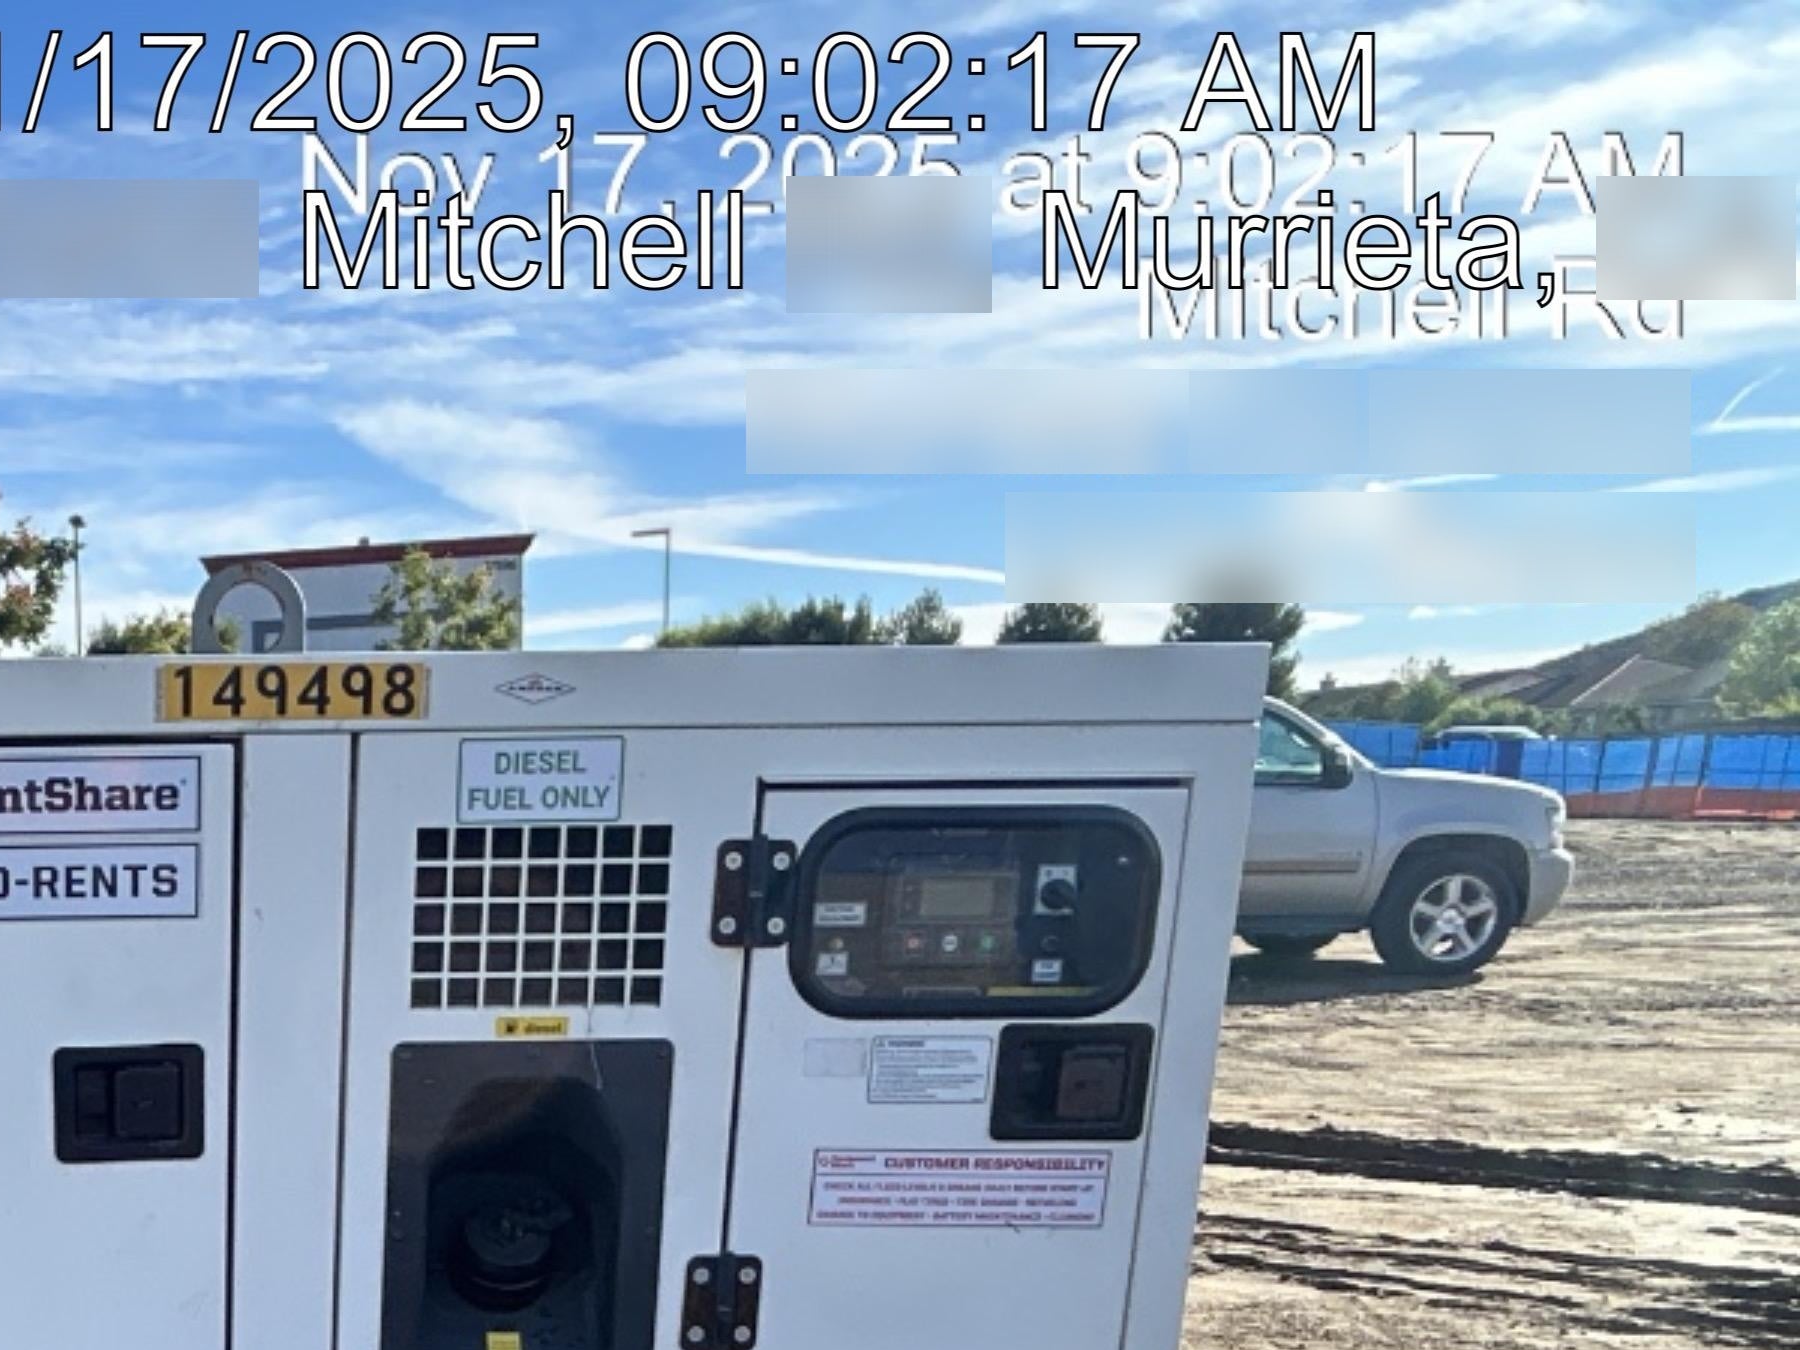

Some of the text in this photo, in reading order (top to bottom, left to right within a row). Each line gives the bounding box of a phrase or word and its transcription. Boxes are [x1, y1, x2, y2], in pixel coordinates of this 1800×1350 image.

[174, 663, 415, 717] 149498
[494, 751, 587, 775] DIESEL
[467, 785, 611, 811] FUEL ONLY
[884, 1157, 969, 1170] CUSTOMER
